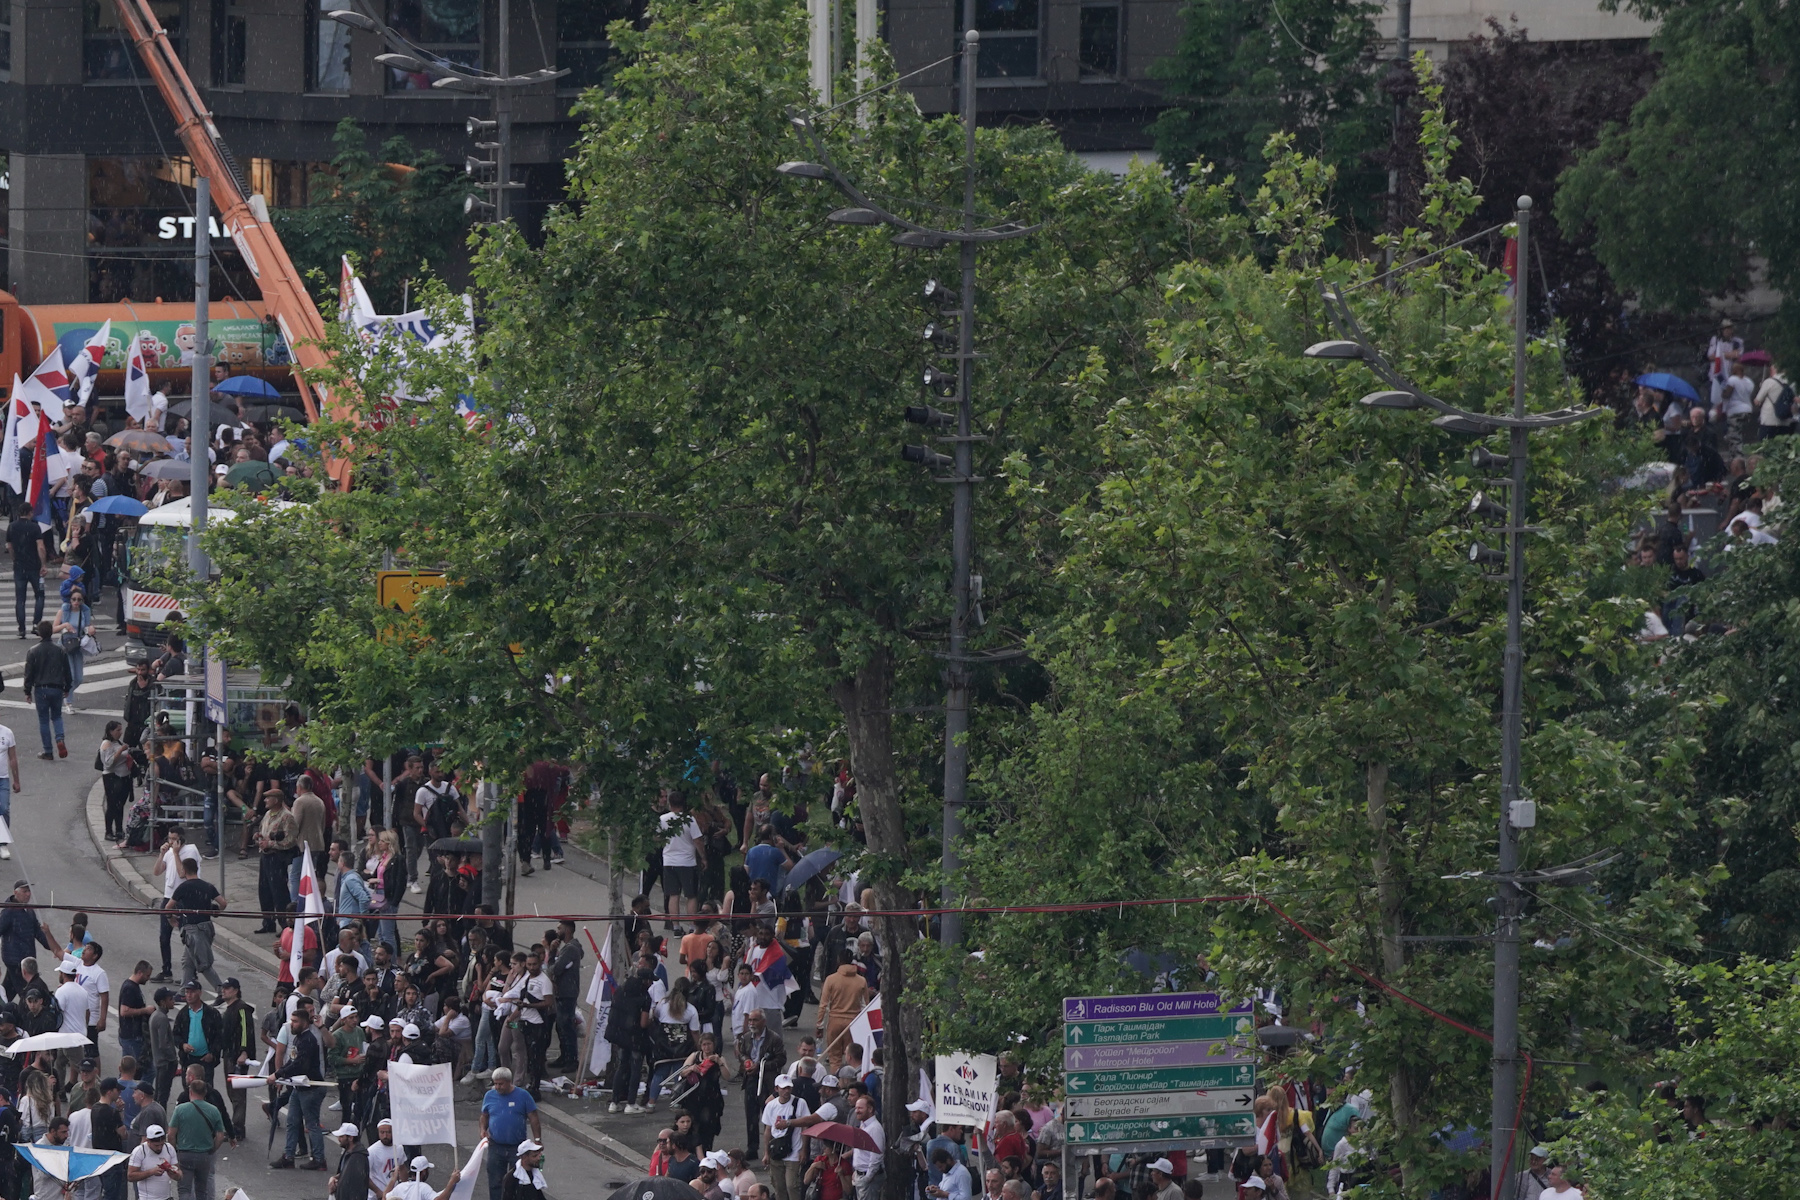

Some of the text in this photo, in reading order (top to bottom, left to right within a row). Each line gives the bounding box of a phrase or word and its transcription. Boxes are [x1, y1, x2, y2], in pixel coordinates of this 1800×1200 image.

[1093, 999, 1218, 1014] Radisson Blu Old Mill Hotel
[1093, 1022, 1166, 1035] Парк Ташмајдан
[1140, 1031, 1160, 1041] Park
[1093, 1056, 1154, 1069] Metropol Hotel
[1093, 1072, 1117, 1082] Хала
[1093, 1095, 1170, 1107] Београдски сајам
[1093, 1105, 1150, 1117] Belgrade Fair
